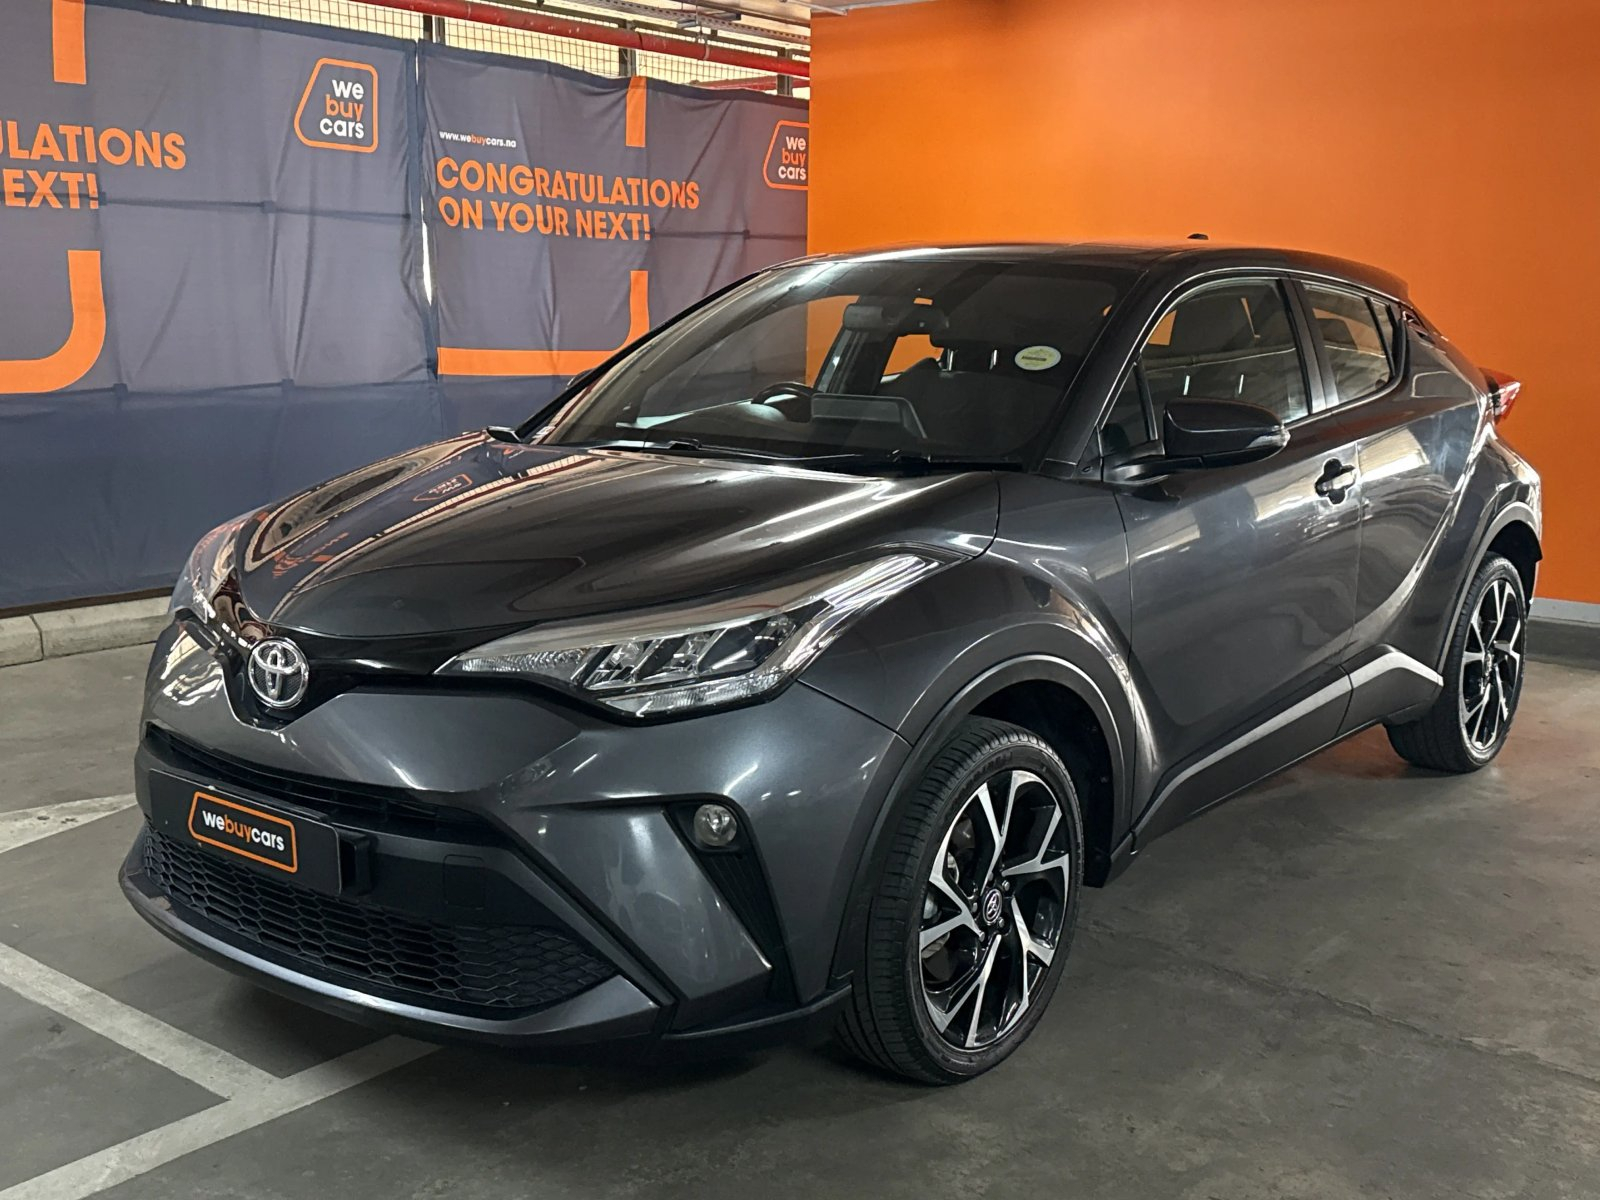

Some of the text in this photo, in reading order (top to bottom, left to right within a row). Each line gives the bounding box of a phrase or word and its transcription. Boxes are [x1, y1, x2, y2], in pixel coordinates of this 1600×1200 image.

[331, 79, 364, 100] we
[325, 94, 364, 122] buy
[319, 118, 365, 139] cars
[0, 121, 186, 170] LATIONS
[439, 131, 517, 148] www.webuycars.na
[785, 136, 807, 151] we
[781, 148, 807, 168] buy
[434, 156, 700, 210] CONGRATULATIONS
[778, 166, 807, 181] cars
[438, 196, 651, 241] ON YOUR NEXT!
[202, 810, 285, 851] webuycars
